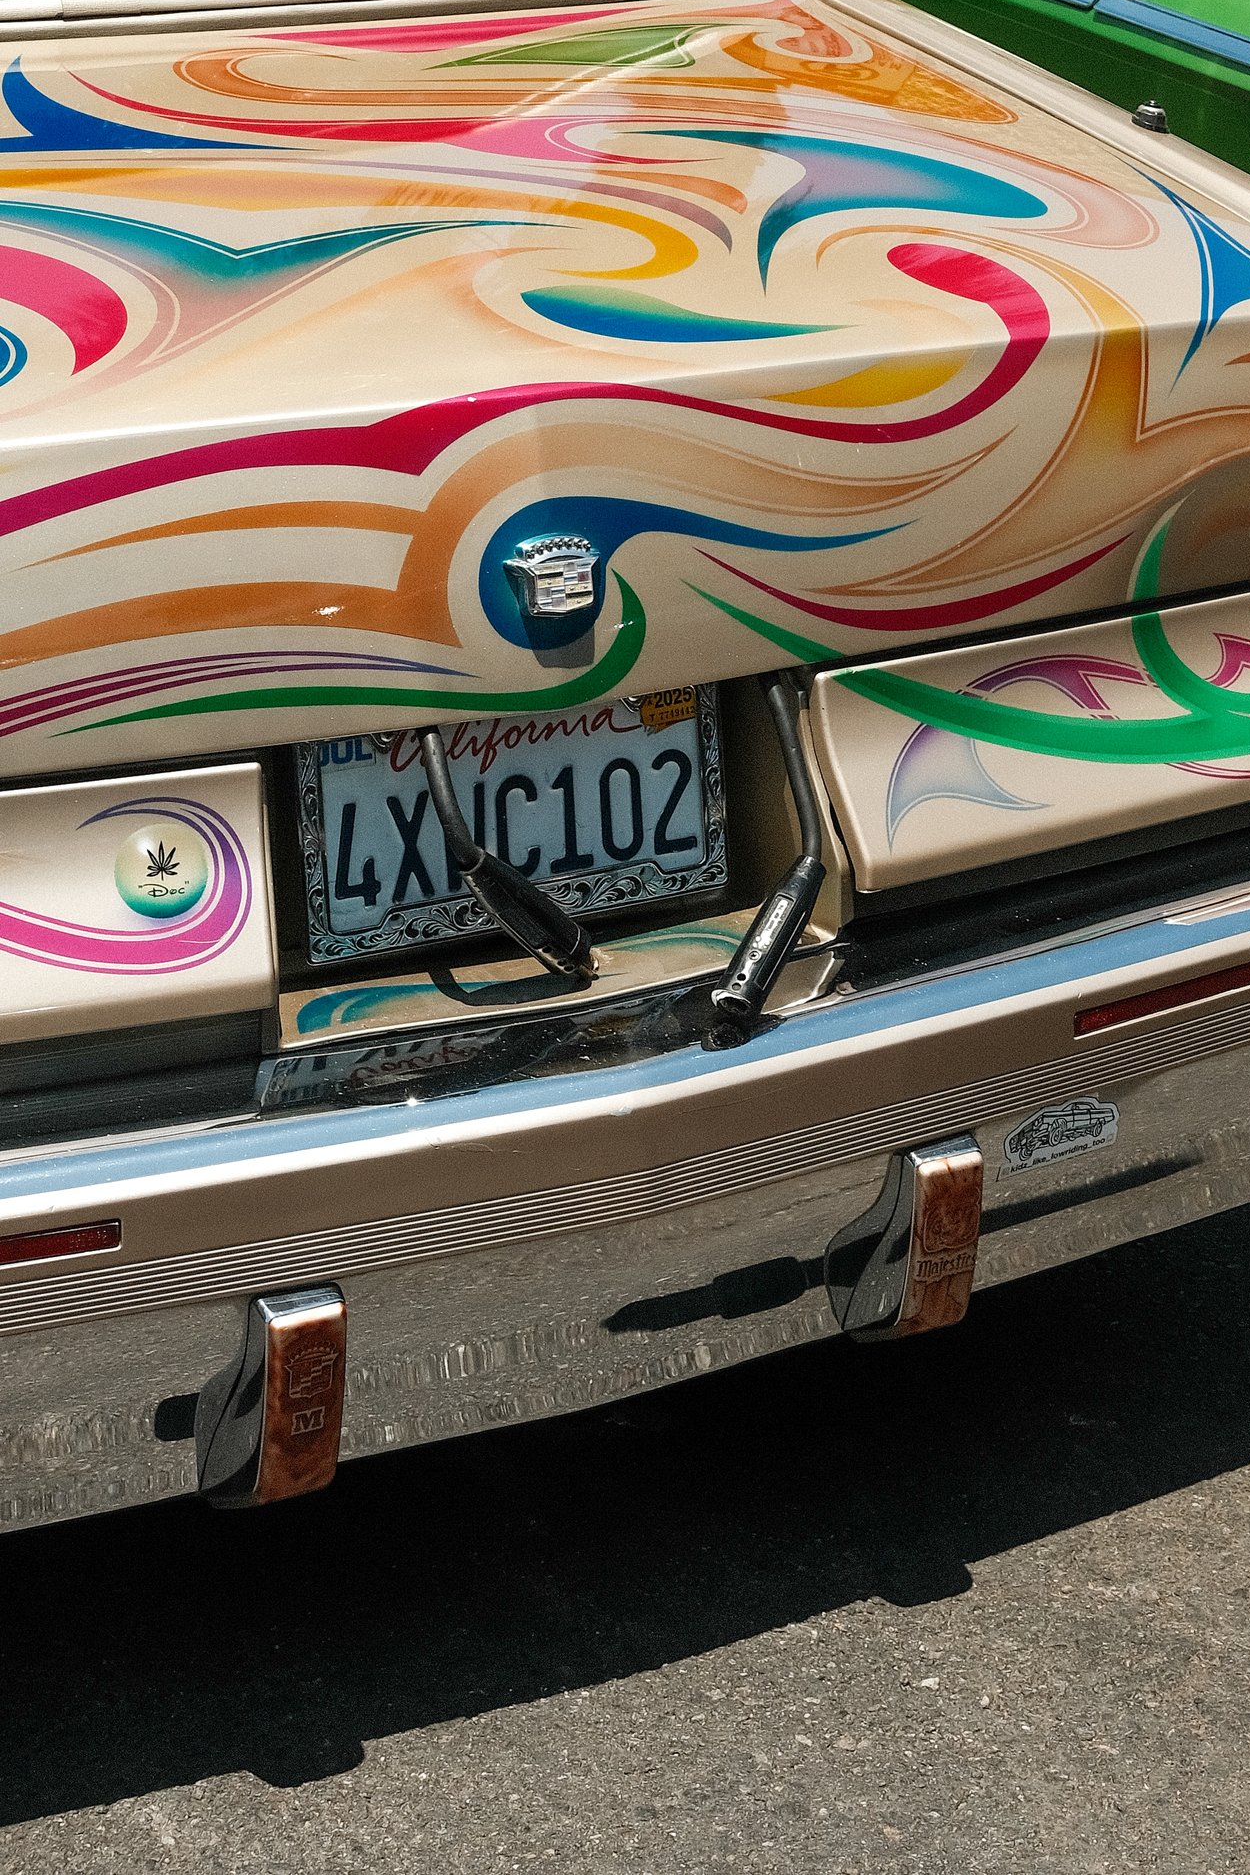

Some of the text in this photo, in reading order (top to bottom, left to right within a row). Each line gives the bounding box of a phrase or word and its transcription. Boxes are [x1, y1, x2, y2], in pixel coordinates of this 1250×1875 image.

[654, 686, 693, 709] 2025
[321, 736, 373, 767] JUL
[390, 703, 641, 774] Clifornia
[917, 1252, 977, 1277] Majestics
